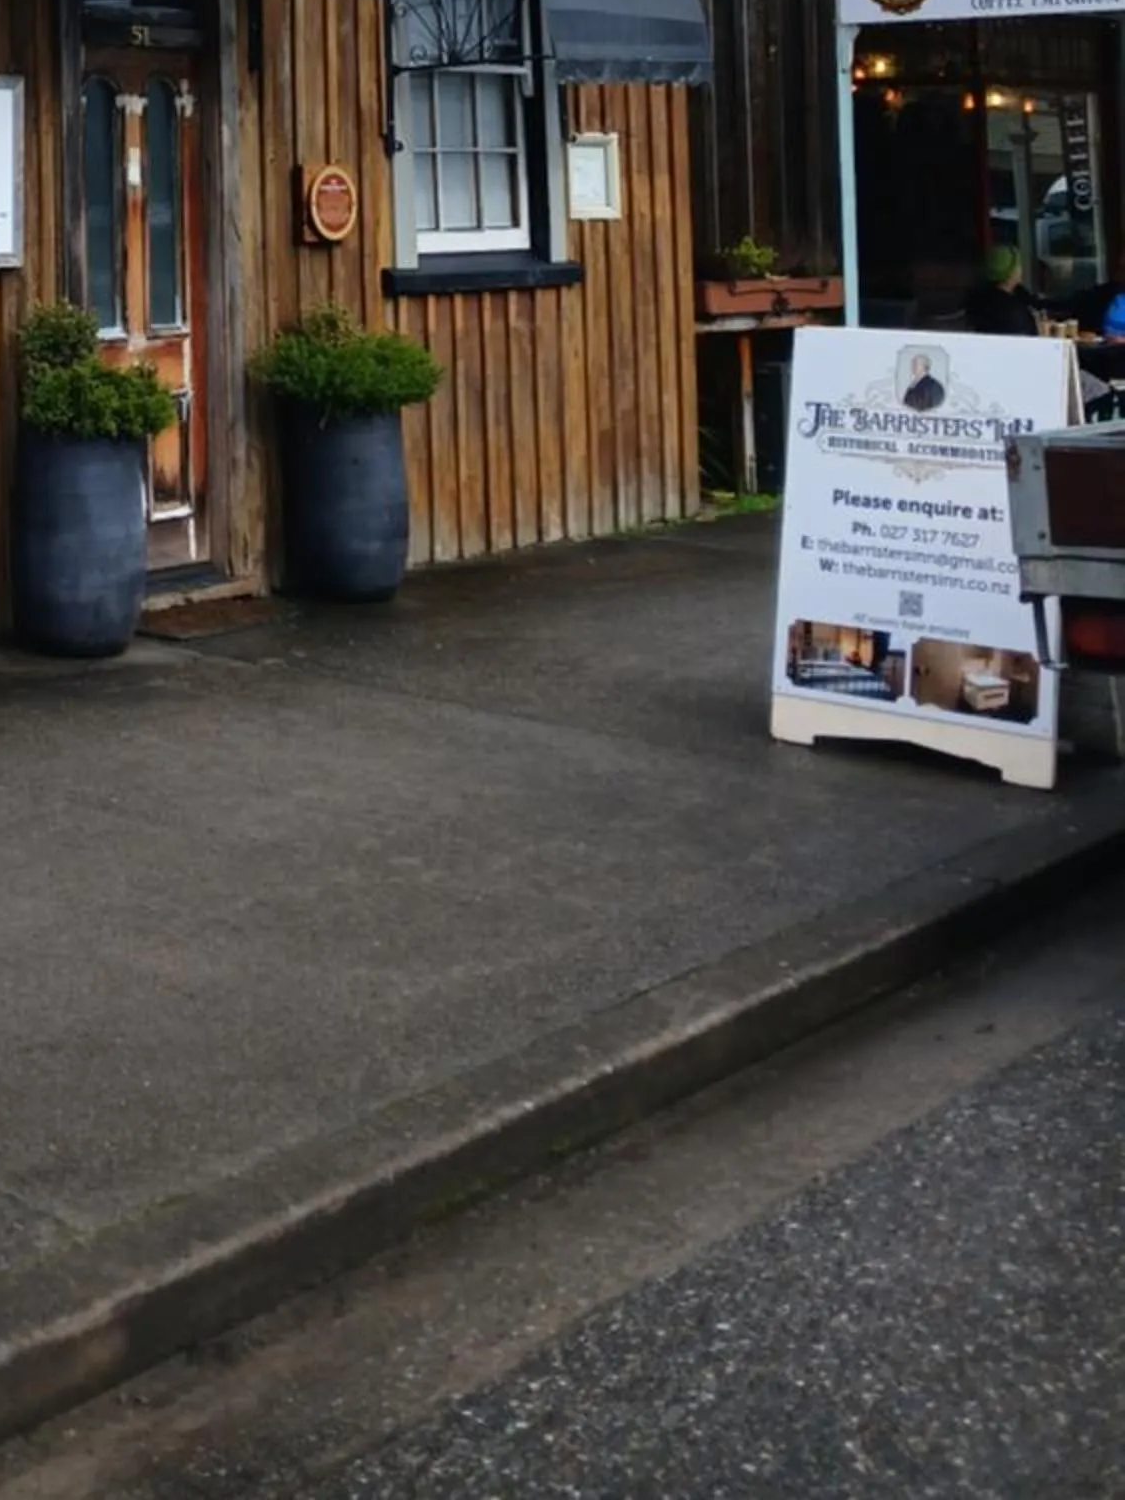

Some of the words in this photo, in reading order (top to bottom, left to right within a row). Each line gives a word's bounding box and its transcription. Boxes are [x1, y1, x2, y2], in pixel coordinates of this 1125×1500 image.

[850, 407, 983, 440] BARRISTERS
[833, 489, 893, 511] Please
[897, 498, 973, 520] enquire
[977, 505, 1005, 522] at:
[852, 520, 876, 537] Ph.
[819, 558, 840, 575] W:
